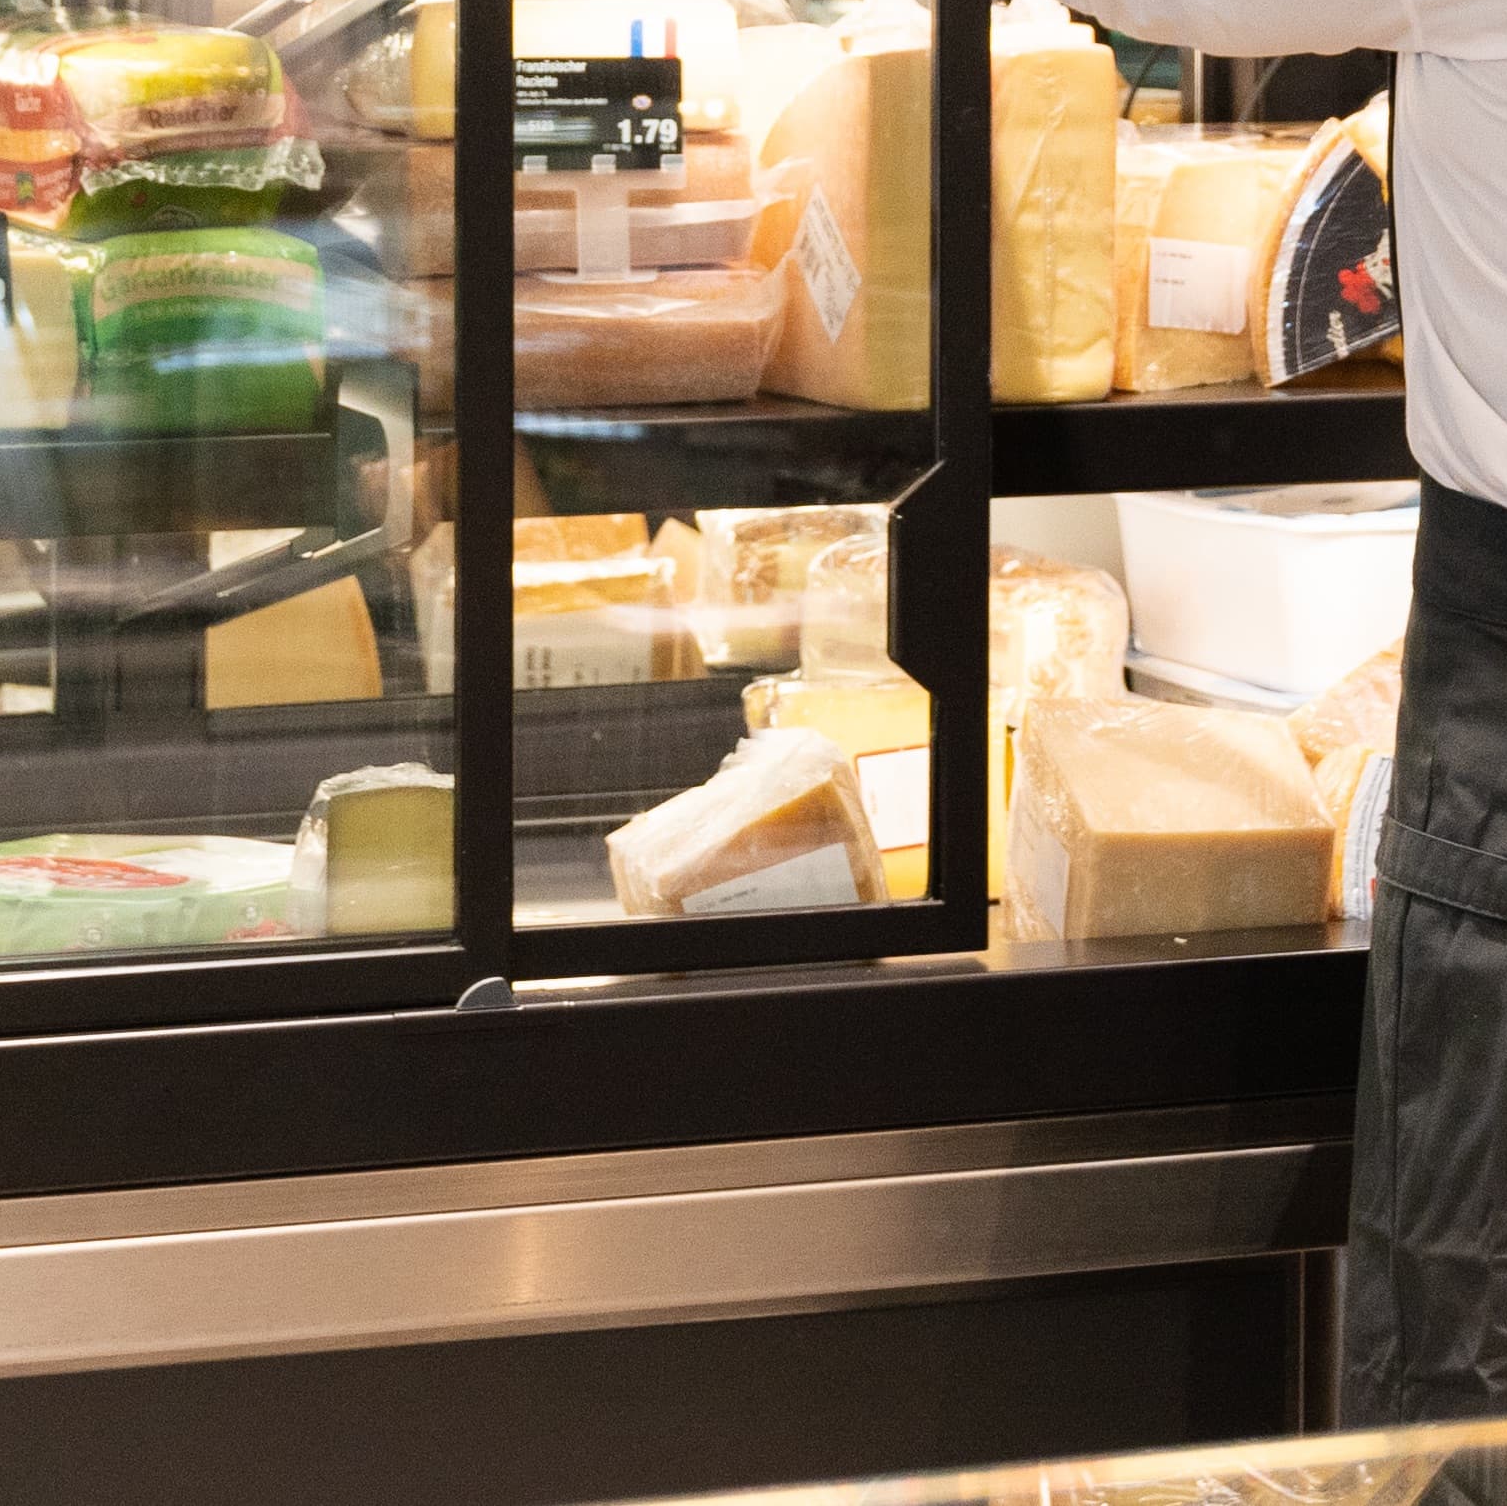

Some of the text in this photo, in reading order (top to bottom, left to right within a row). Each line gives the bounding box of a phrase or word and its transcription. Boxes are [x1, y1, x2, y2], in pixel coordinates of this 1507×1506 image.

[515, 59, 588, 74] Französischer
[515, 74, 559, 88] Raclette
[616, 118, 679, 145] 1.79
